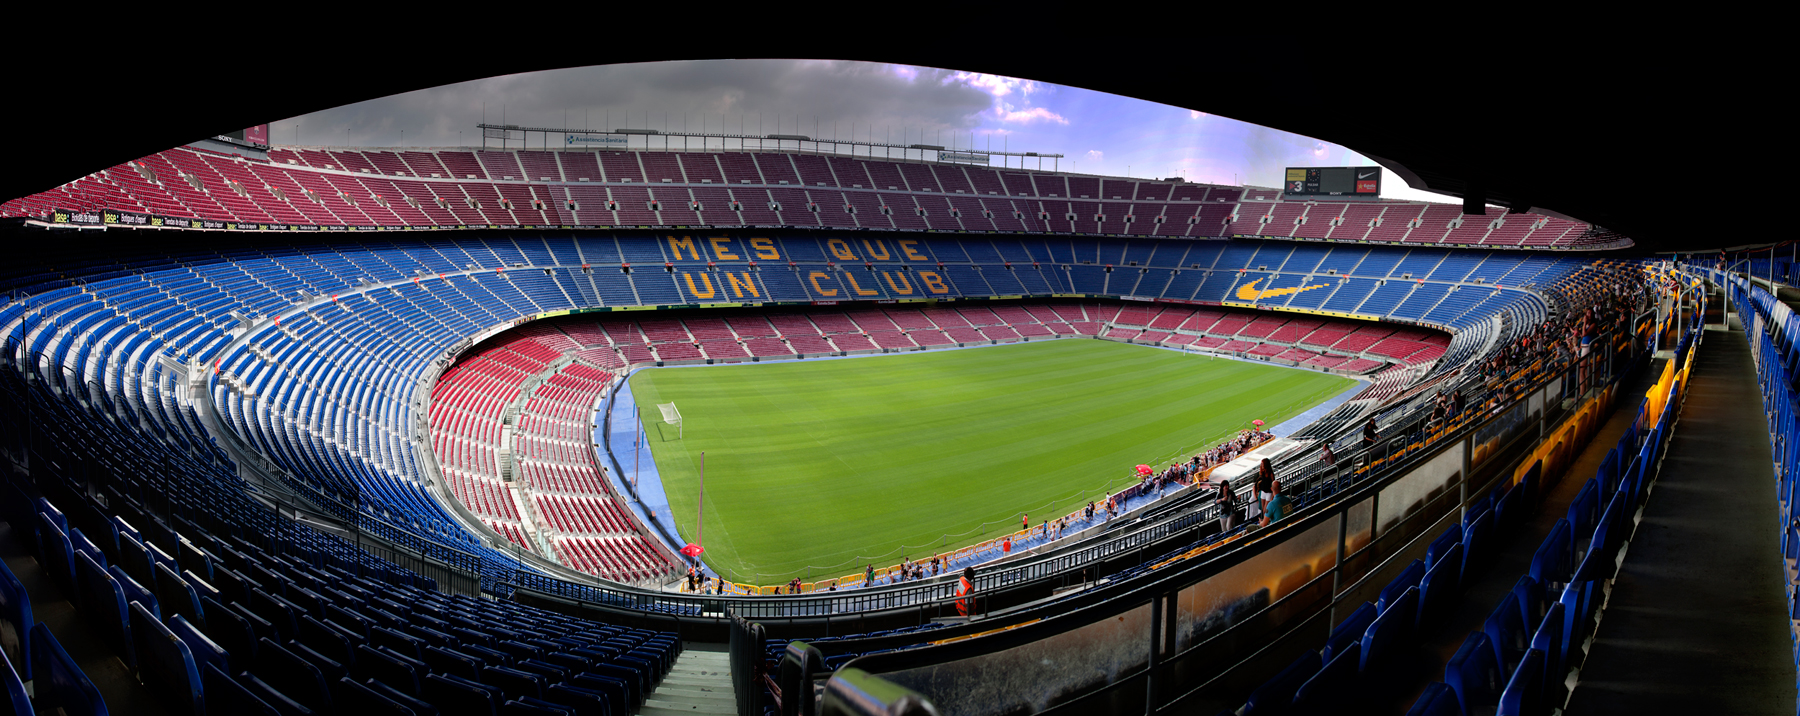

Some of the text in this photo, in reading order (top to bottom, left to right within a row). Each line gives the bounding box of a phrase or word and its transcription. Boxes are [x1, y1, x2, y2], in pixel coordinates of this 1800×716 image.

[827, 239, 928, 261] QUE
[682, 271, 949, 299] UN CLUB
